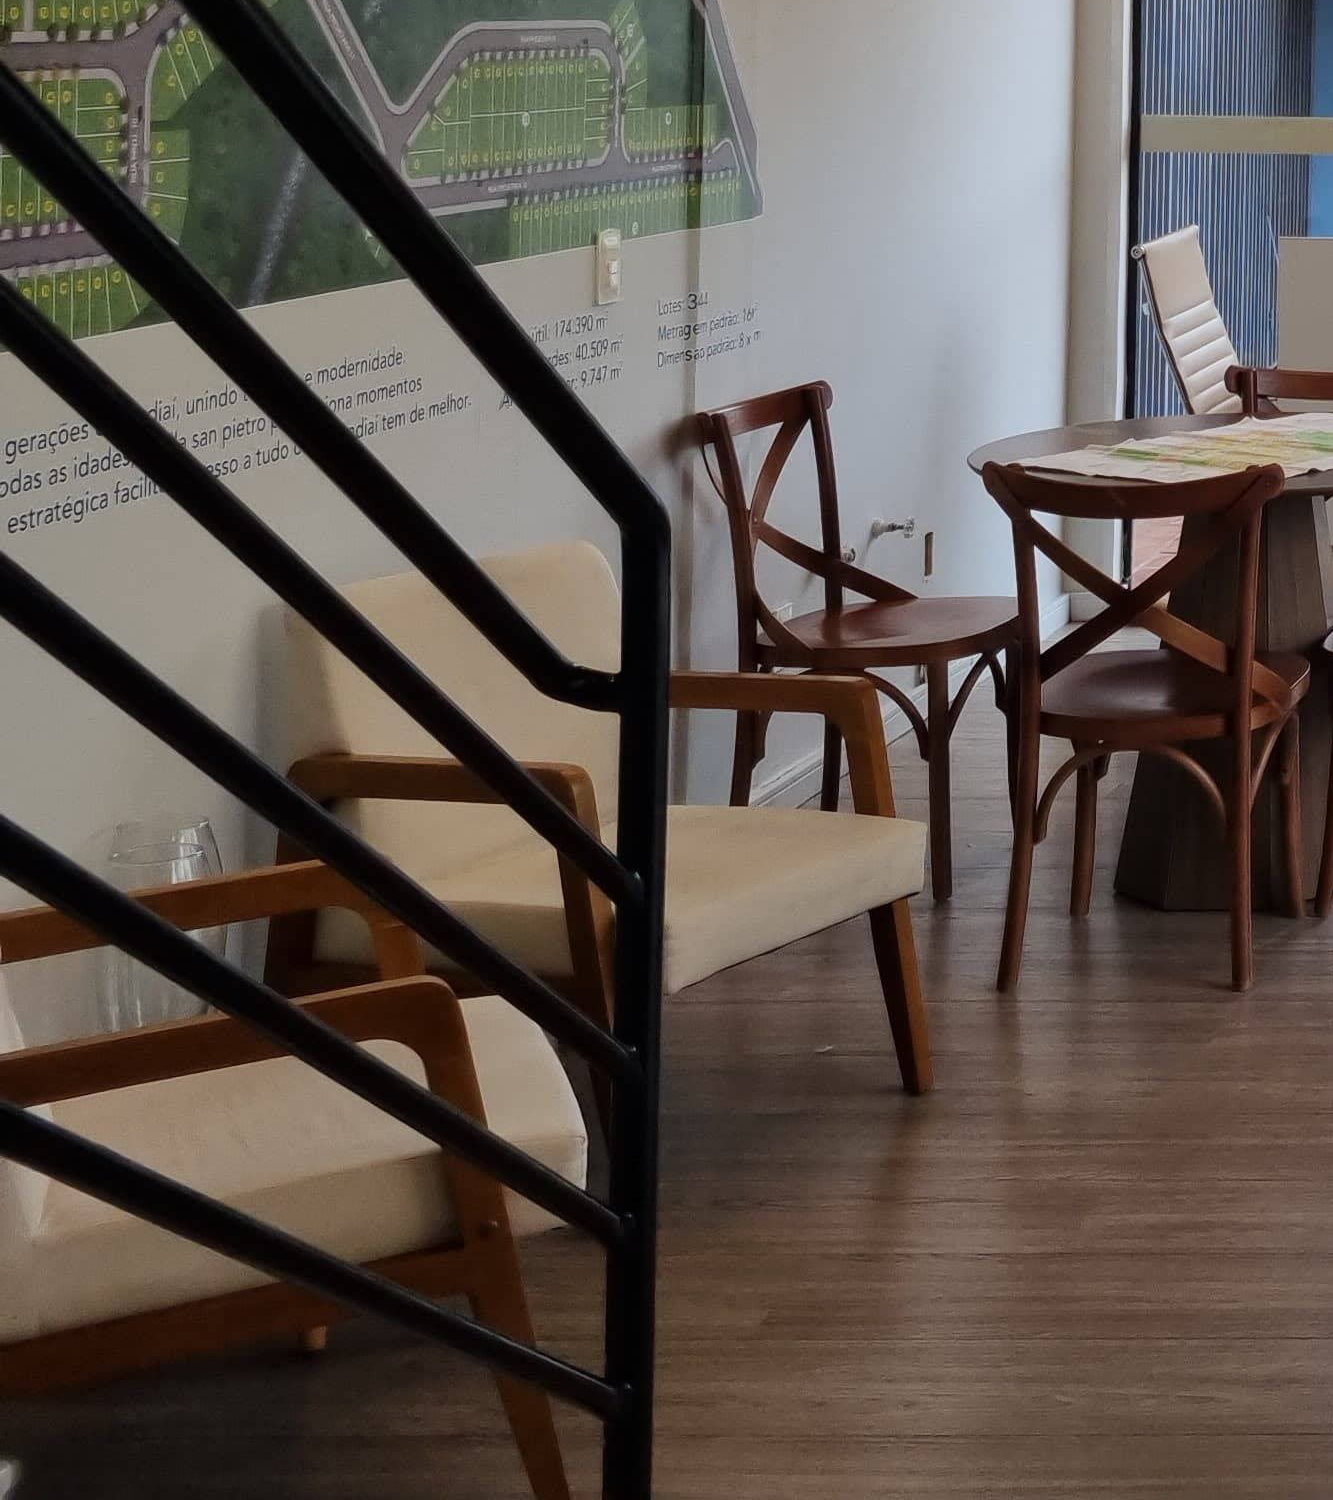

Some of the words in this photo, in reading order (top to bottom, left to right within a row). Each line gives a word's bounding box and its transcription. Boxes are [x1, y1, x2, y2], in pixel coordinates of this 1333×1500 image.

[0, 468, 42, 498] odas
[49, 466, 68, 486] as
[191, 428, 217, 449] san
[222, 416, 266, 449] pietro
[356, 376, 423, 407] momentos
[5, 422, 89, 464] gerações
[185, 384, 238, 415] unindo
[7, 490, 109, 534] estratégica
[206, 458, 238, 478] esso
[243, 455, 251, 470] a
[256, 438, 289, 467] tudo
[381, 413, 406, 432] tem
[410, 402, 425, 424] de
[428, 393, 472, 419] melhor.
